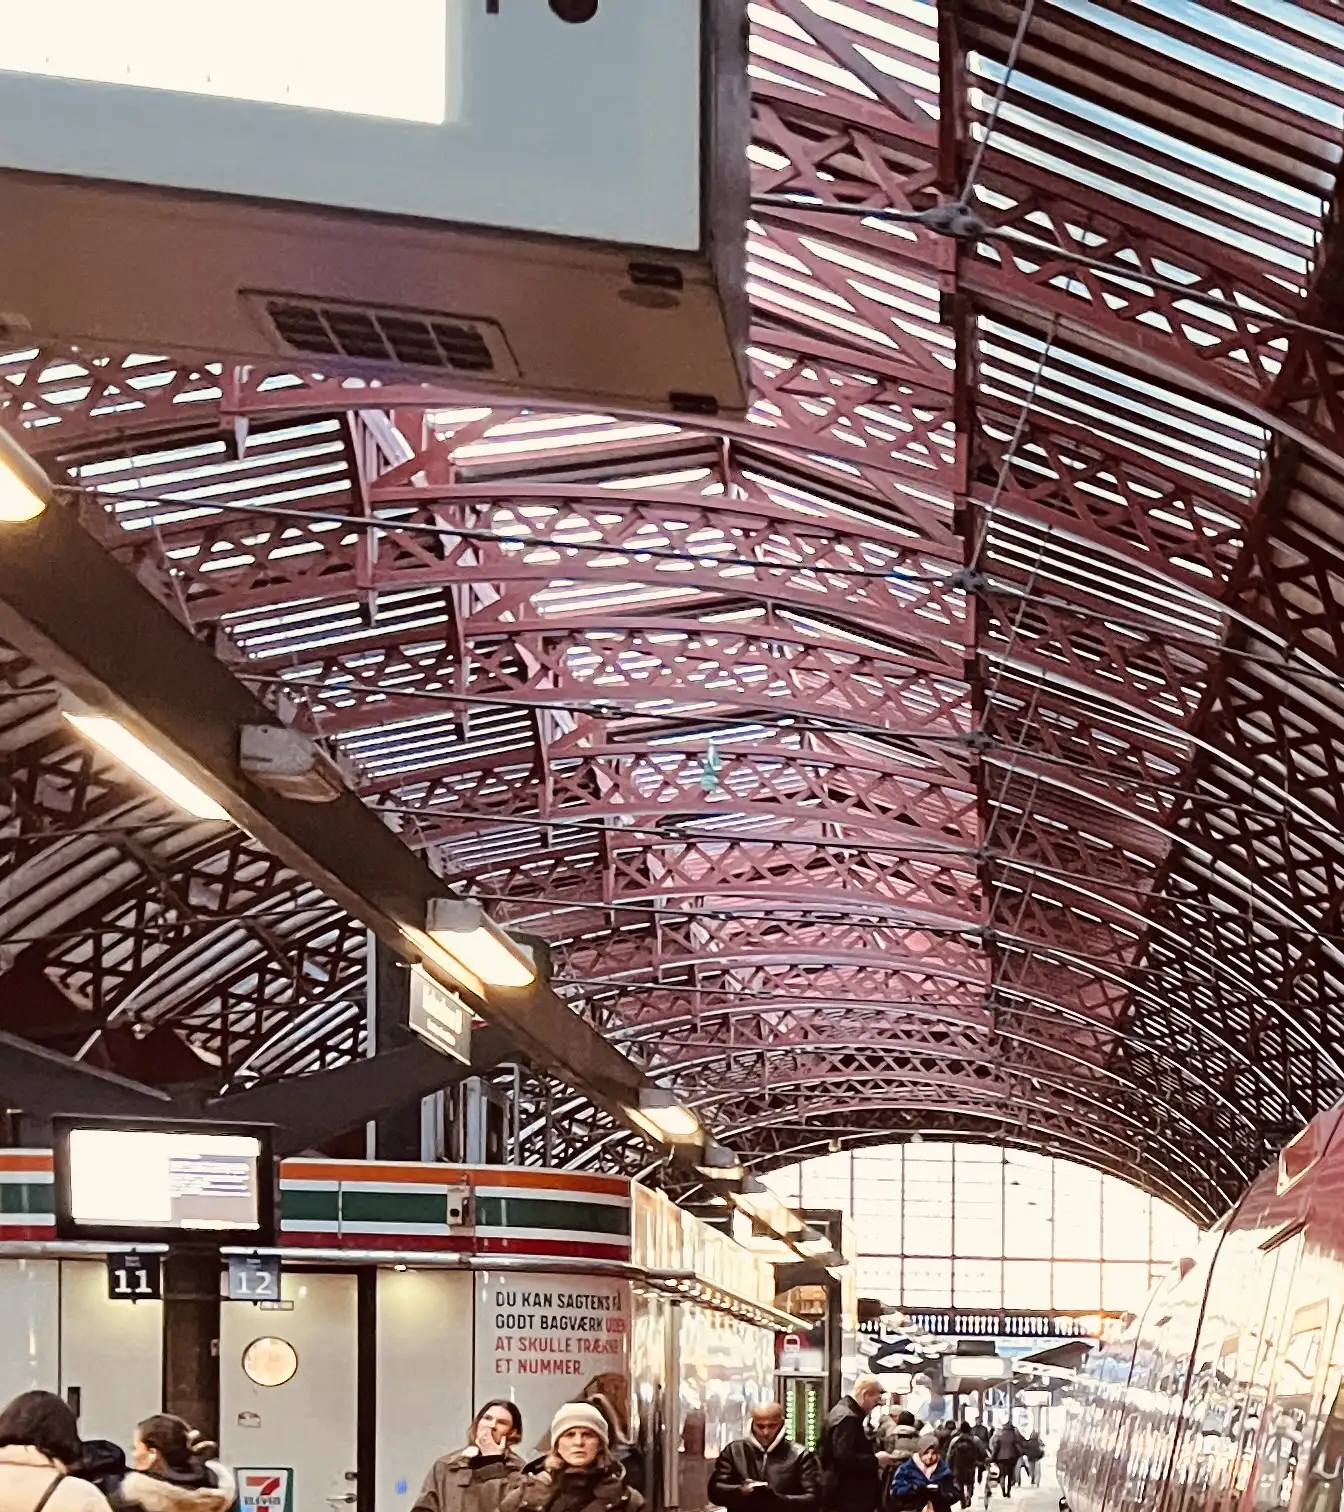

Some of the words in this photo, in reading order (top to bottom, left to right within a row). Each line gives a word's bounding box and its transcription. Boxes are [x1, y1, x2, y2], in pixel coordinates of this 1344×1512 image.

[114, 1269, 152, 1294] 11
[236, 1271, 273, 1295] 12
[495, 1291, 516, 1307] DU
[522, 1292, 552, 1308] KAN
[557, 1294, 610, 1311] SAGTENS
[495, 1314, 535, 1329] GODT
[540, 1315, 603, 1332] BAGVÆRK
[495, 1336, 513, 1352] AT
[518, 1336, 572, 1353] SKULLE
[495, 1358, 512, 1374] ET
